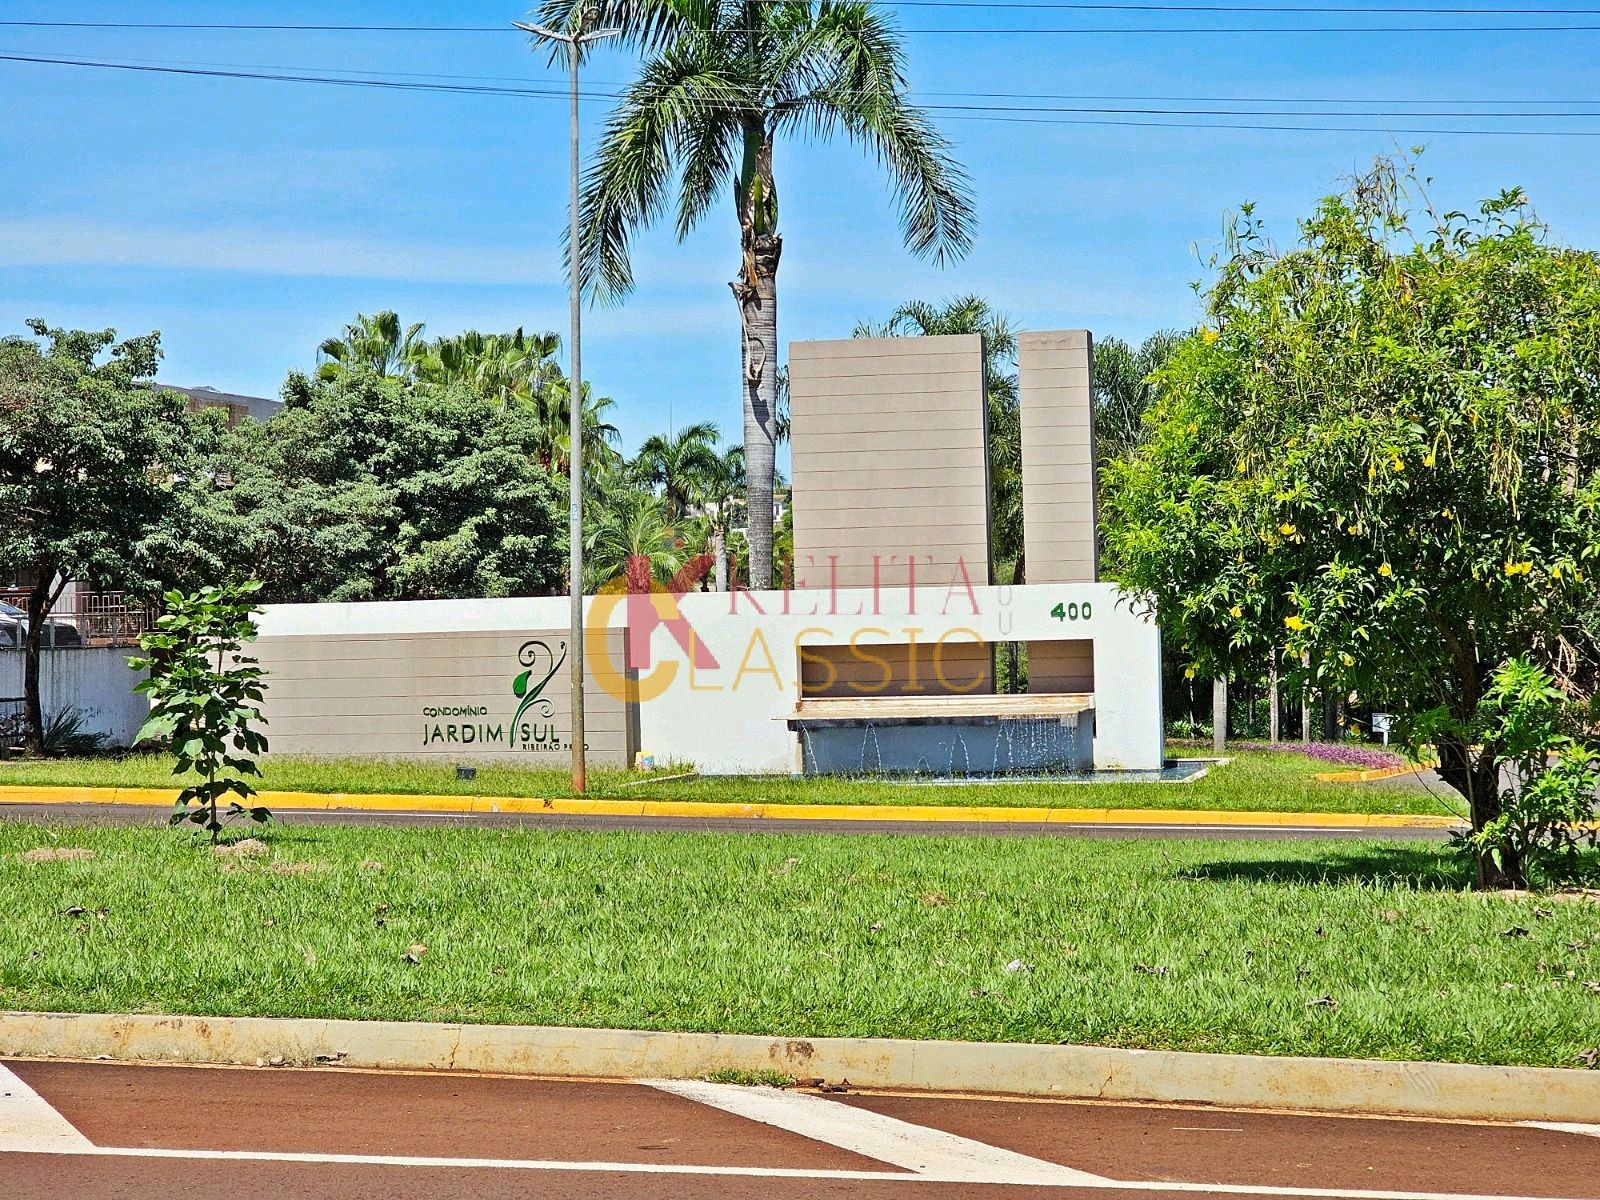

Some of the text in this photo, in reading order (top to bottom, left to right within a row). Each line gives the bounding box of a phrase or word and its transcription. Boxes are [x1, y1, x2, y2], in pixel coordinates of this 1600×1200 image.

[1050, 601, 1093, 622] 400
[423, 704, 488, 718] CONDOMÍNIO
[423, 723, 560, 746] JARDIM SUL
